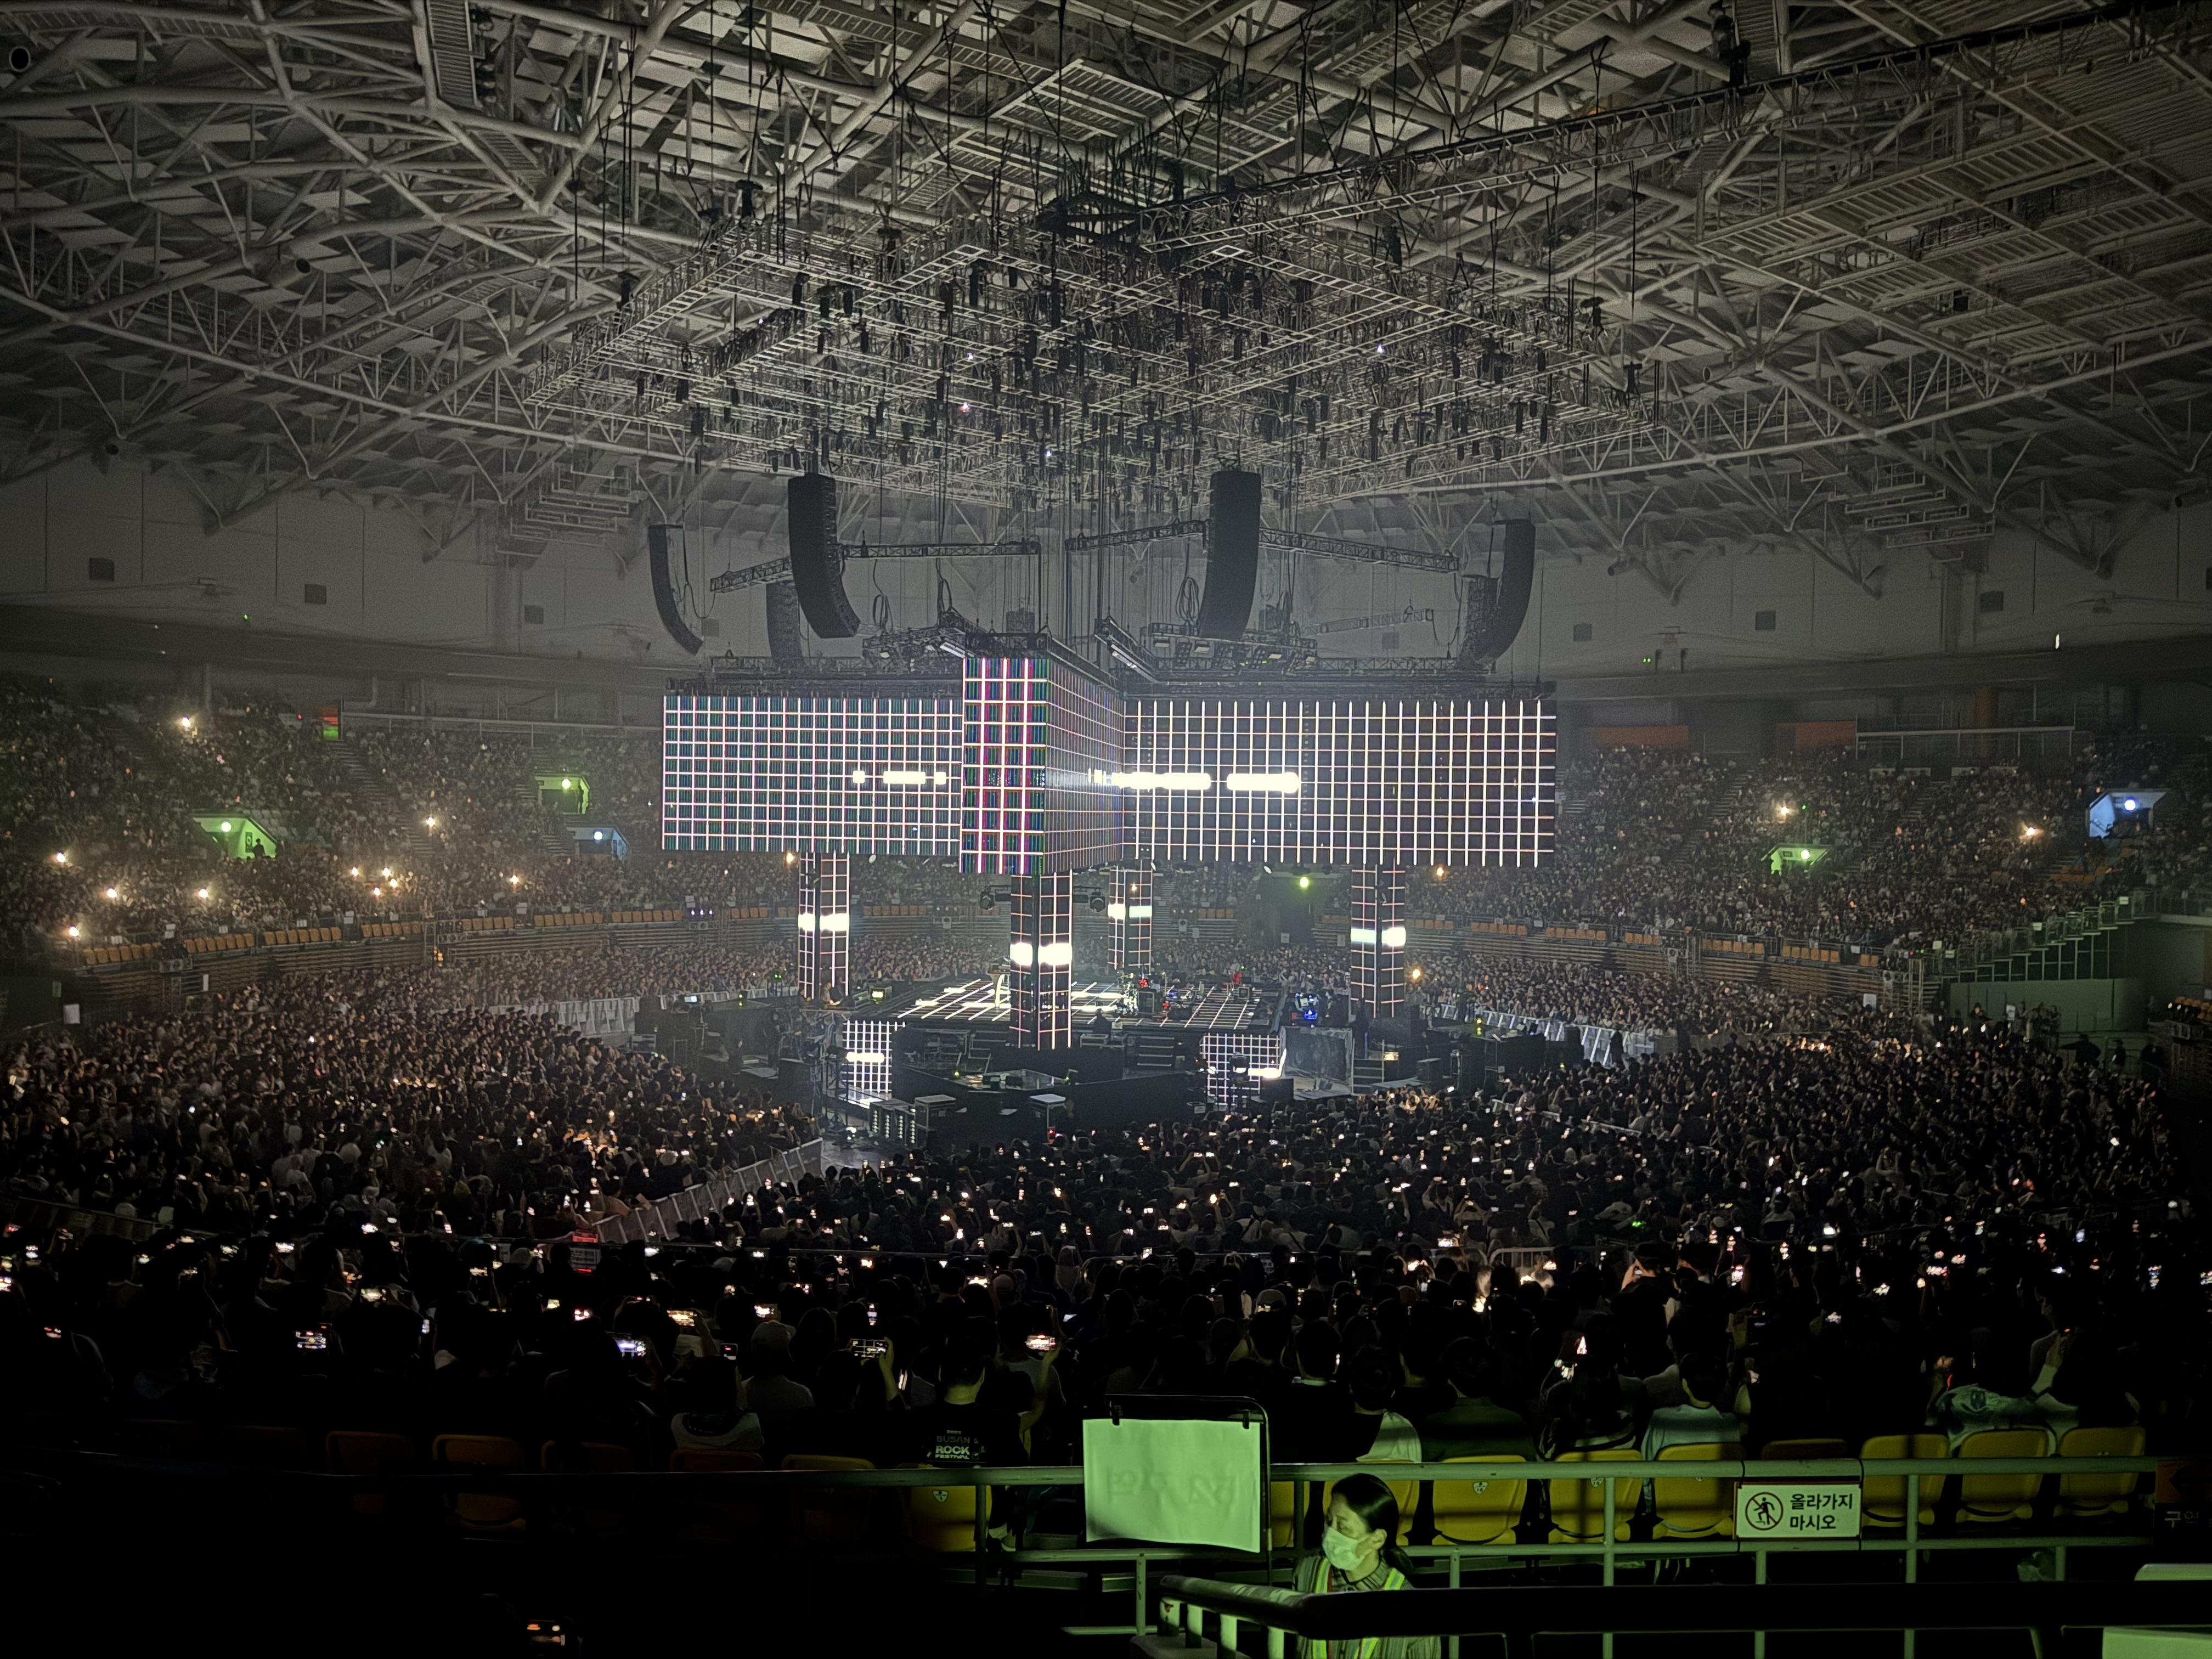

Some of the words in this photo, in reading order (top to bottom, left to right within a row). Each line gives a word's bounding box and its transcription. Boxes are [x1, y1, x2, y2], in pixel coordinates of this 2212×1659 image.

[936, 1435, 970, 1443] BUSAN
[935, 1446, 970, 1455] ROCK
[1791, 1494, 1852, 1510] 올라가지
[1791, 1515, 1836, 1530] 마시오
[2164, 1510, 2199, 1528] 구역
